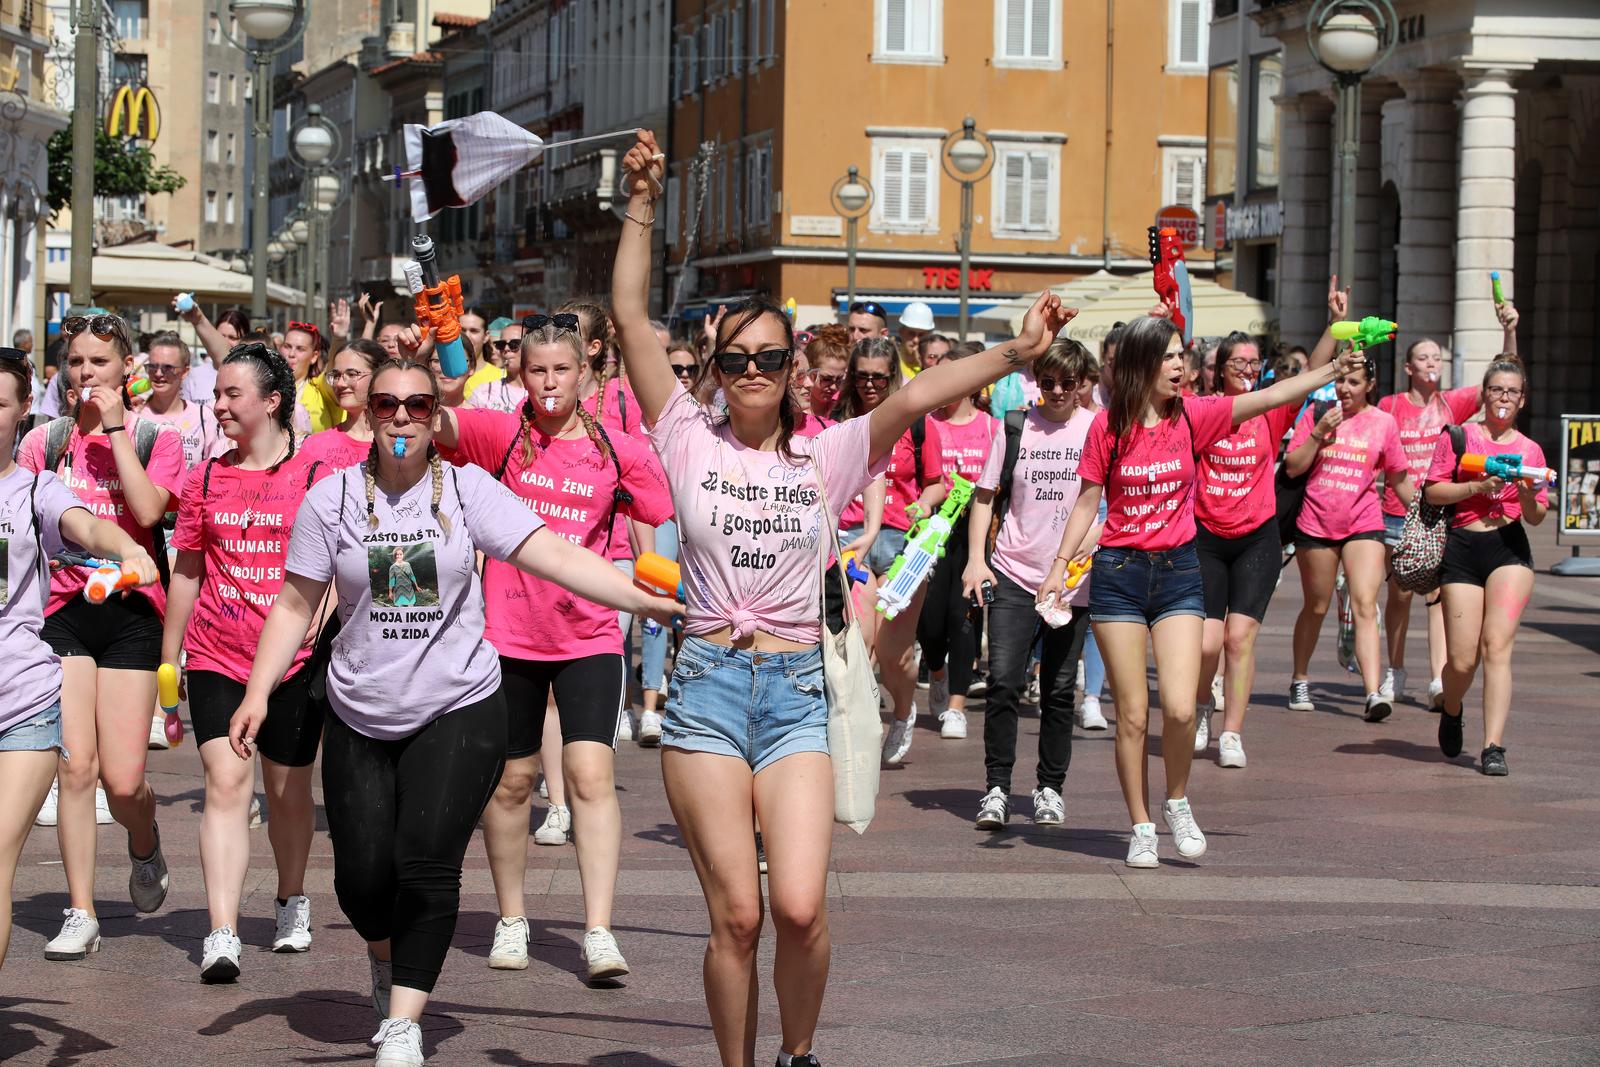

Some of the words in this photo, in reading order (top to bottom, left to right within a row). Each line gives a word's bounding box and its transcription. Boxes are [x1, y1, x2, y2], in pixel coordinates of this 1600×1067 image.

[1016, 447, 1027, 461] 2
[1030, 448, 1062, 461] sestre
[1209, 454, 1257, 465] TULUMARE
[1322, 450, 1367, 463] TULUMARE
[1024, 467, 1029, 480] i
[1031, 467, 1077, 484] gospodin
[1121, 464, 1149, 477] KADA
[70, 479, 88, 490] DA
[95, 478, 125, 491] ŽEN
[520, 470, 555, 490] KADA
[561, 477, 595, 498] ŽENE
[701, 470, 719, 492] 22
[720, 480, 769, 502] sestre
[773, 484, 818, 507] Helge
[1035, 487, 1064, 501] Zadro
[87, 503, 124, 516] MARE
[1166, 499, 1179, 511] SE
[253, 511, 283, 527] ŽENE
[710, 505, 719, 527] i
[722, 513, 803, 541] gospodin
[362, 531, 399, 543] ZAŠTO
[400, 528, 424, 543] BAŠ
[425, 528, 440, 539] TI,
[730, 545, 777, 570] Zadro
[267, 567, 281, 580] SE
[369, 611, 403, 623] MOJA
[405, 609, 444, 622] IKONO
[382, 628, 399, 640] SA
[401, 628, 430, 640] ZIDA
